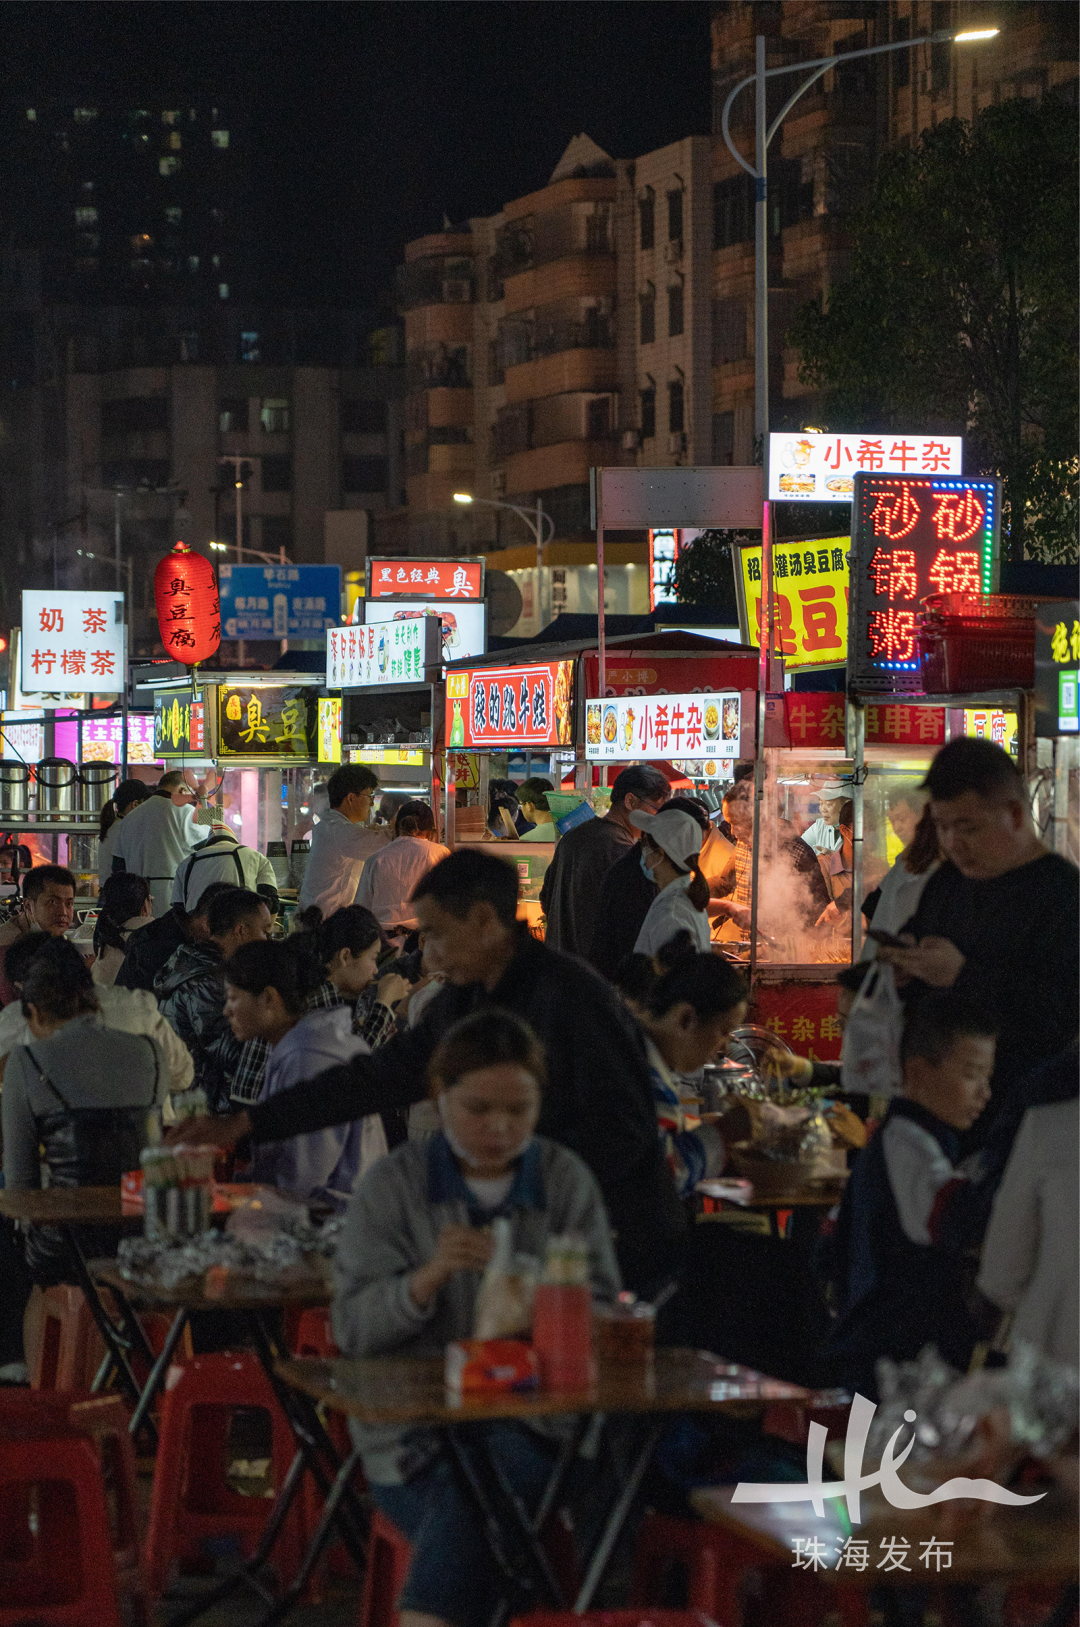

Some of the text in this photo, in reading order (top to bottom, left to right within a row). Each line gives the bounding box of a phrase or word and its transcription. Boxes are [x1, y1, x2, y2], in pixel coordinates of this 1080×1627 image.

[824, 438, 951, 472] 小希牛杂
[379, 565, 474, 598] 黑色经典 臭
[747, 547, 849, 582] 招灌汤臭豆腐
[868, 486, 921, 660] 砂锅粥
[39, 607, 107, 633] 奶茶
[163, 577, 195, 648] 臭豆腐
[755, 585, 849, 653] 臭豆
[31, 649, 115, 675] 柠檬茶
[238, 694, 318, 743] 臭豆
[474, 676, 547, 735] 辣的跳牛蛙
[638, 702, 702, 751] 小希牛杂
[964, 711, 1007, 750] 豆腐
